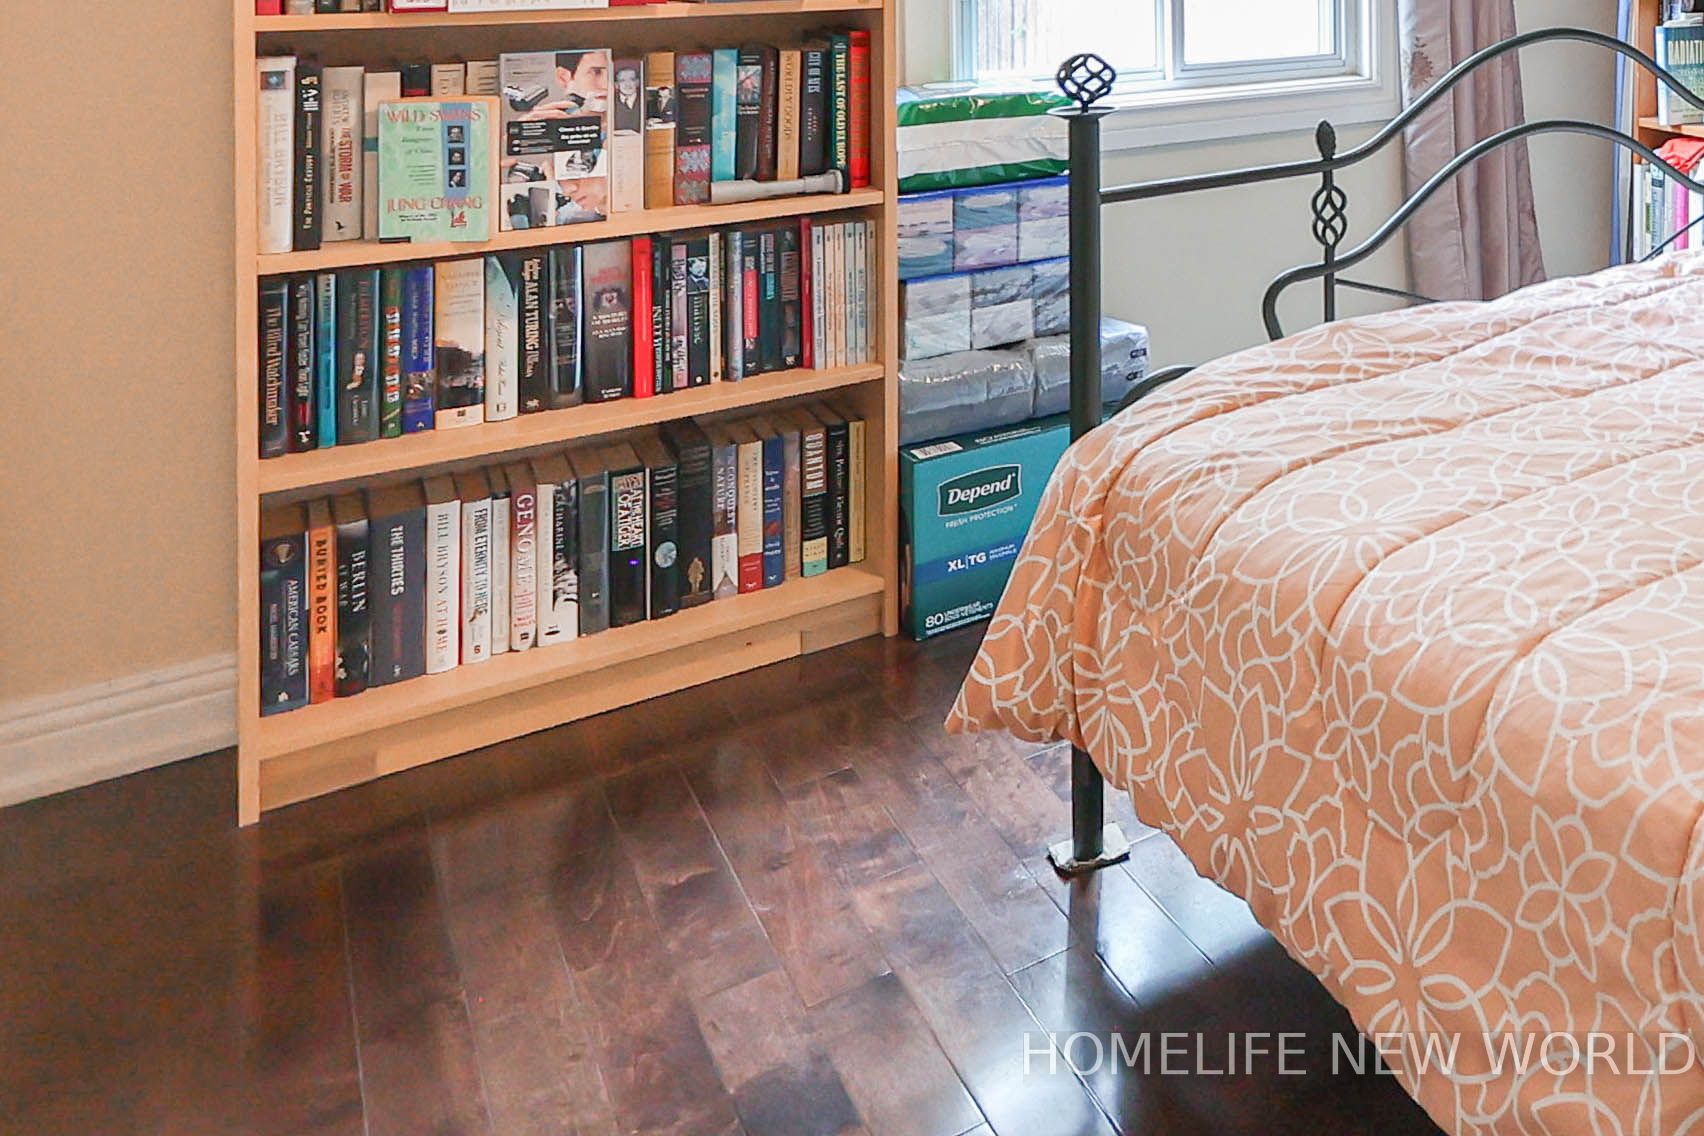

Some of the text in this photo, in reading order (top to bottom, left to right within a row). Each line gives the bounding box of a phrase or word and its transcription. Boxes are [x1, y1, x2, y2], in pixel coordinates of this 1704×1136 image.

[835, 53, 846, 72] THE
[835, 73, 846, 97] LAST
[386, 107, 481, 124] WILD SWANS
[835, 98, 846, 110] OF
[835, 110, 846, 129] OLD
[784, 106, 794, 141] GOODS
[339, 140, 353, 203] STORM WAR
[387, 196, 482, 214] JUNG CHANG
[524, 282, 539, 351] ALAN TURING
[265, 328, 283, 357] Blind
[265, 358, 283, 425] Watchmaker
[806, 432, 825, 489] QUANTUM
[618, 494, 631, 508] OF
[946, 473, 1012, 505] Depend
[474, 508, 488, 534] FROM
[970, 505, 1014, 522] PROTECTION
[516, 494, 534, 586] GENOME
[618, 519, 631, 546] TIGER
[390, 525, 404, 595] THE THIRTIES
[437, 513, 449, 613] BILL BRYSON AT
[474, 535, 488, 576] ETERNITY
[315, 539, 328, 634] BURIED BOOK
[351, 550, 367, 612] BERLIN
[287, 579, 300, 632] AMERICAN
[925, 612, 944, 628] 80
